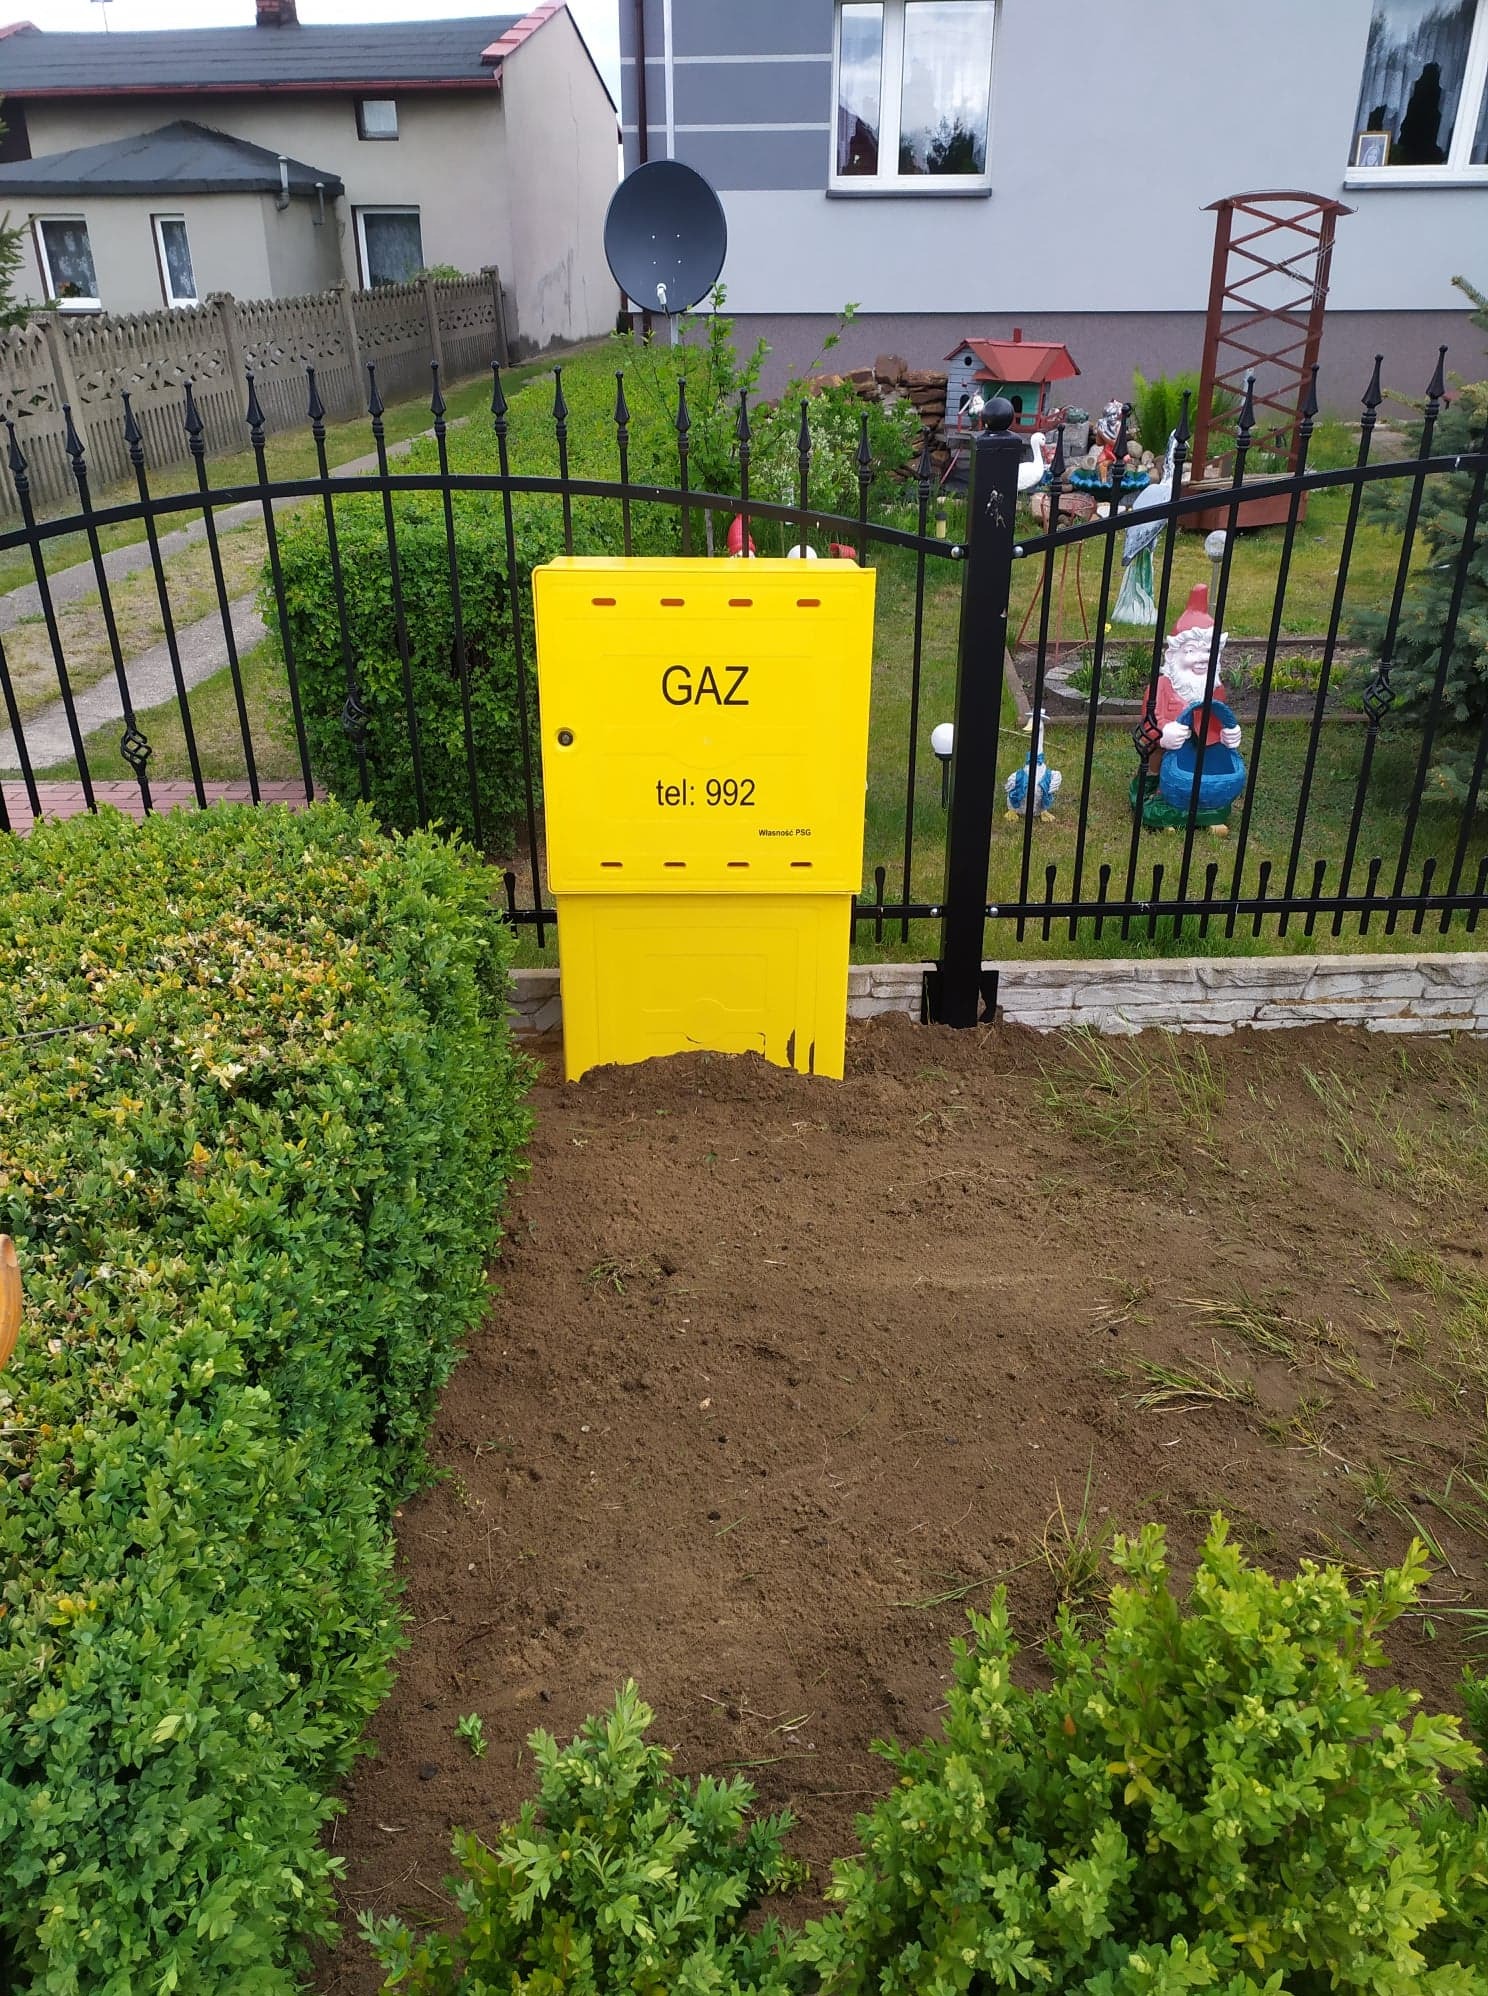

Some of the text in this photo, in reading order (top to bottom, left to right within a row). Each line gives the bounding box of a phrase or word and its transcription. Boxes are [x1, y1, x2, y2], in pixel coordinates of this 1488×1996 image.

[662, 665, 749, 706] GAZ
[656, 778, 755, 806] tel: 992
[795, 828, 812, 837] PSG
